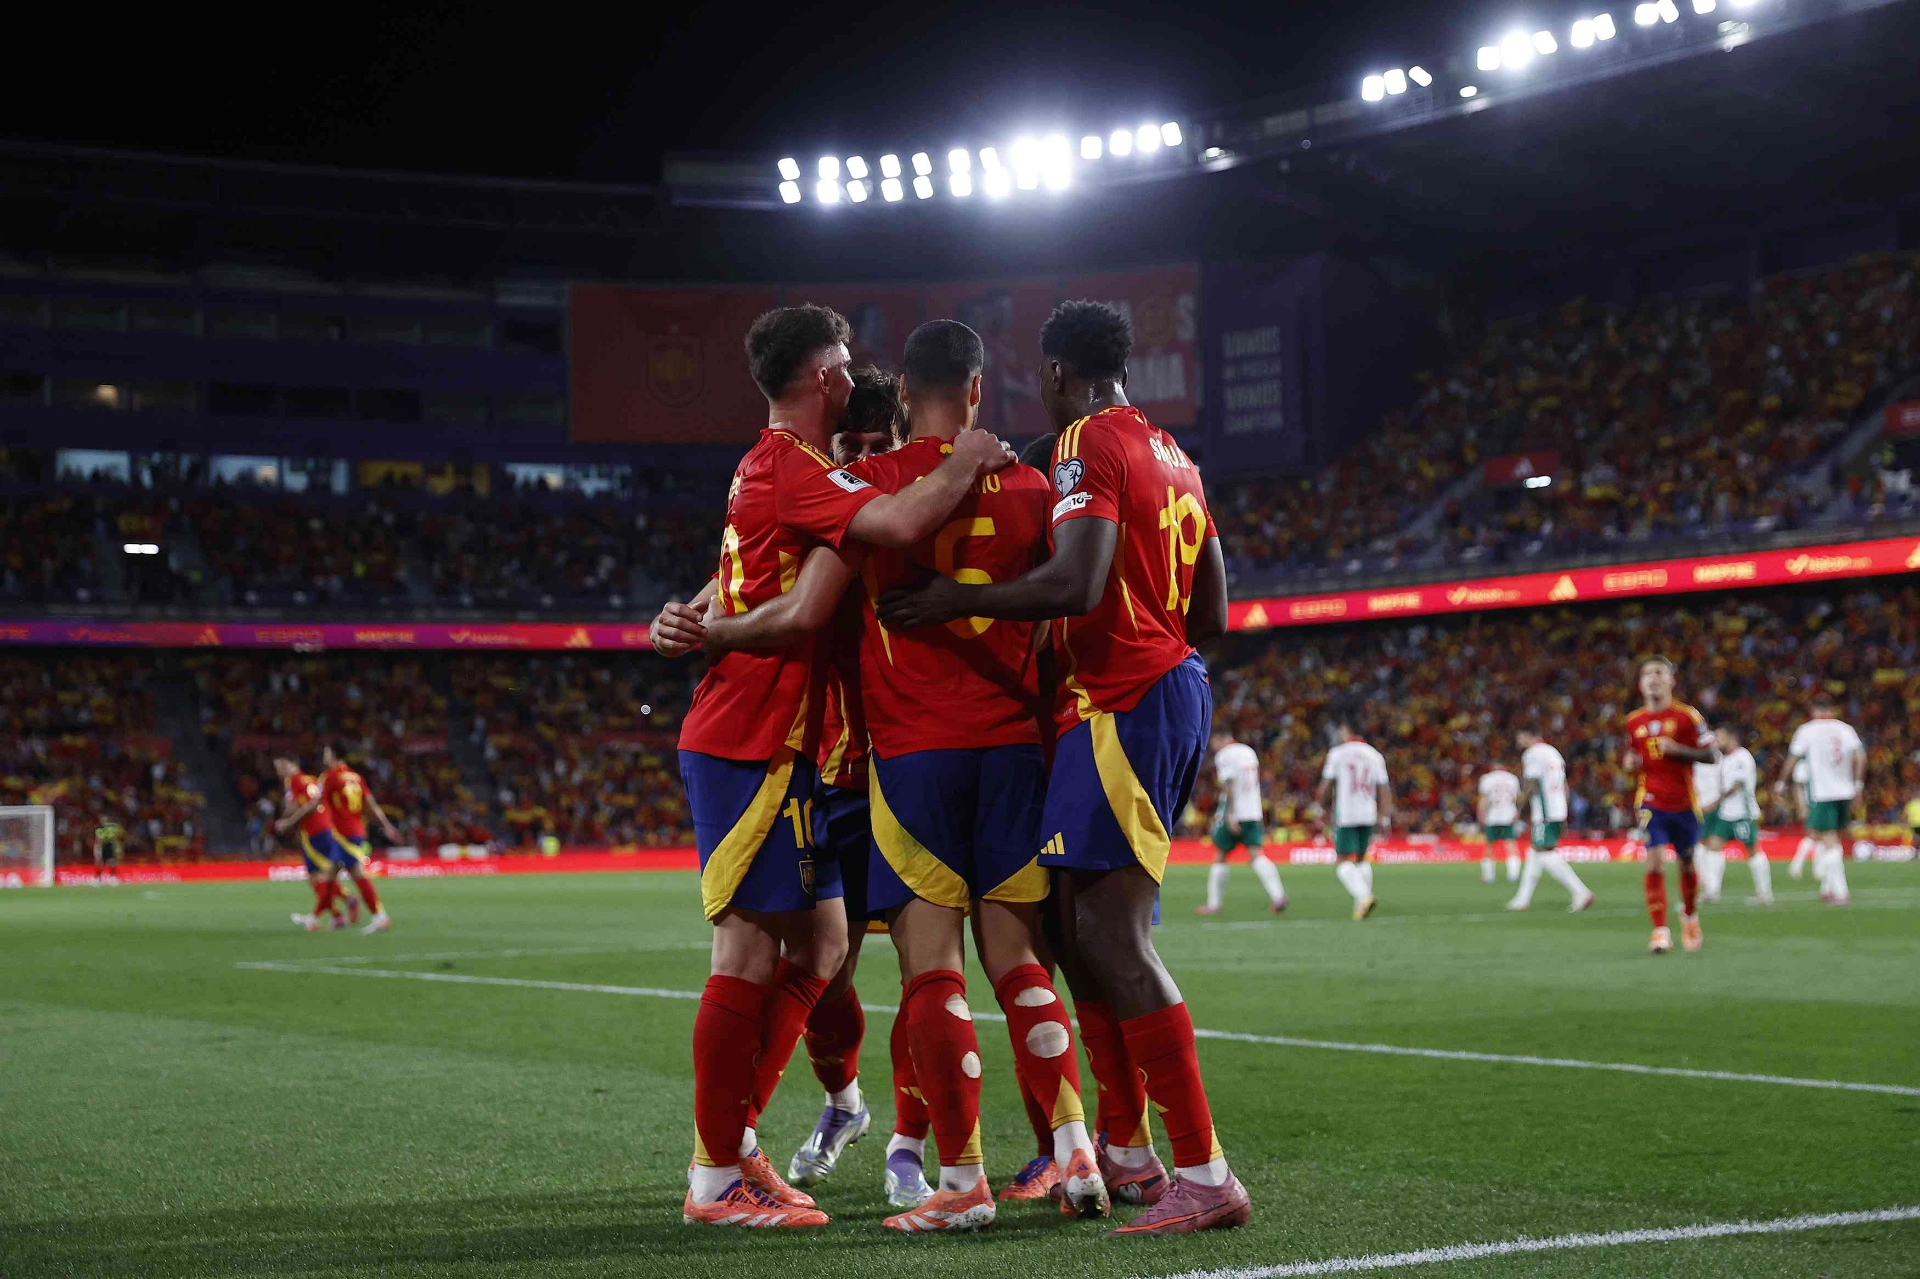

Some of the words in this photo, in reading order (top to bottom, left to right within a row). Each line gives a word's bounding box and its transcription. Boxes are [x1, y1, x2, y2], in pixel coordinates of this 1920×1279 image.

[718, 523, 749, 613] 0
[935, 517, 996, 639] 6
[1158, 485, 1207, 616] 19
[783, 797, 816, 849] 10
[1346, 763, 1374, 798] 14
